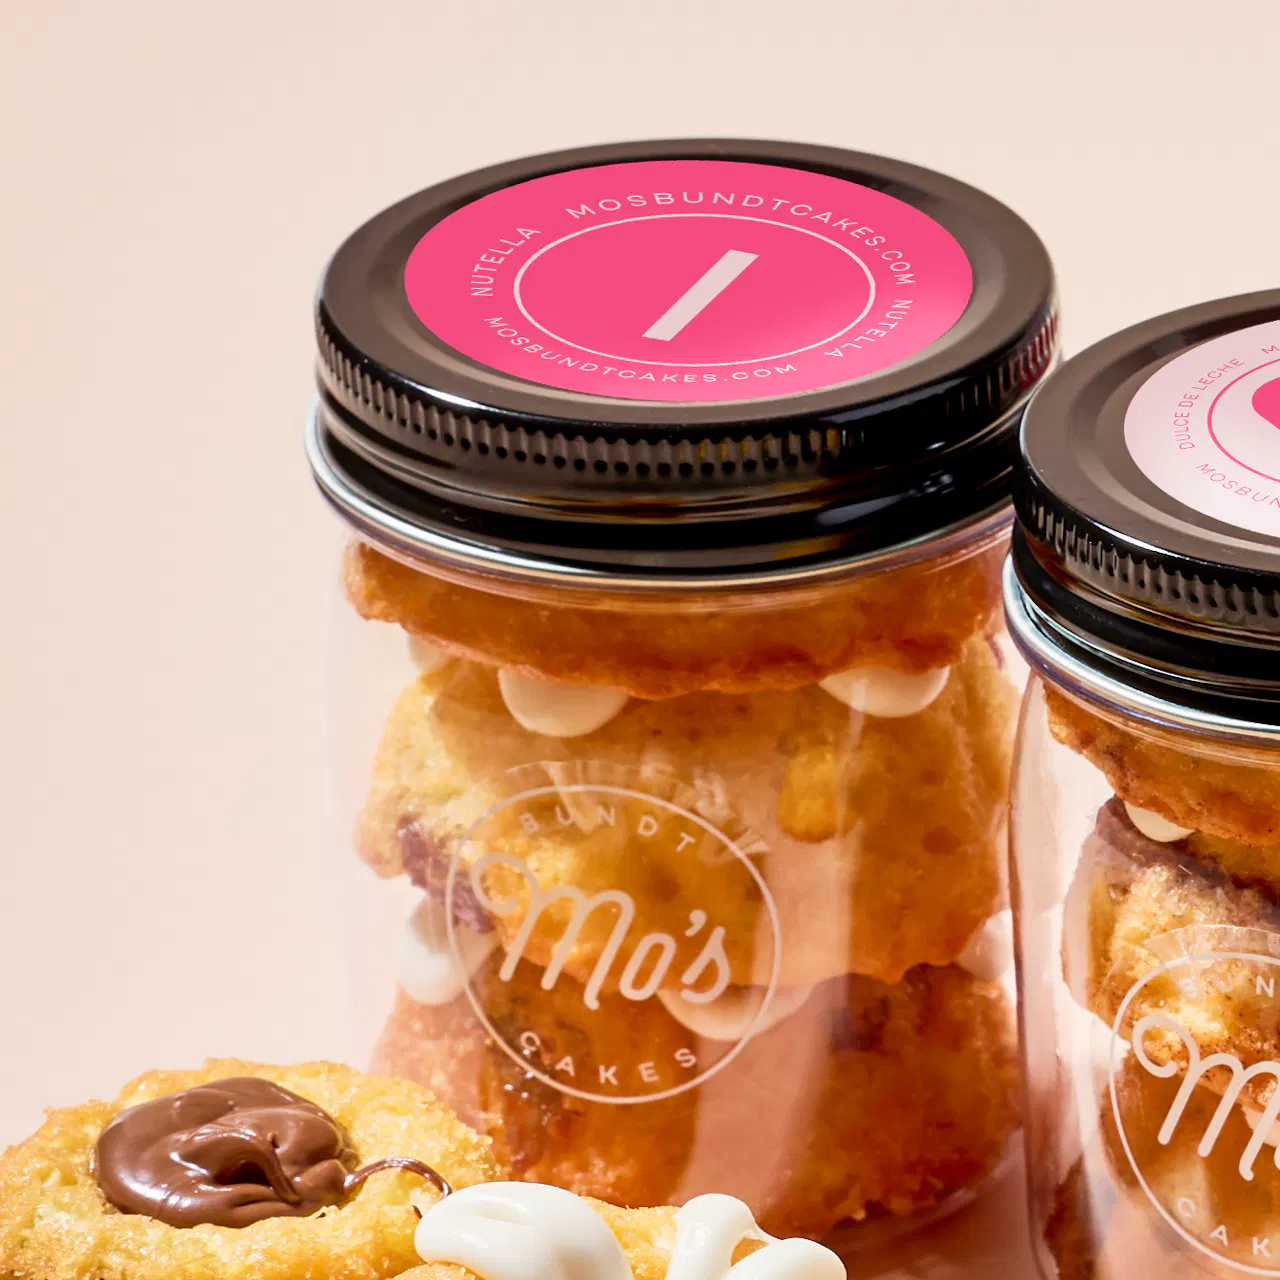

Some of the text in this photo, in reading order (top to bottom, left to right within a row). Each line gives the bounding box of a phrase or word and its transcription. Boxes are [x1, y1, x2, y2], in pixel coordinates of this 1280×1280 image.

[471, 227, 542, 297] NUTELLA
[565, 192, 916, 285] MOSBUNDTCAKES.COM
[484, 317, 797, 383] MOSBUNDTCAKES.COM
[824, 299, 913, 358] NUTELLA
[1173, 358, 1246, 450] DULCE DE LECHE
[519, 805, 697, 853] BUNDT
[470, 851, 732, 1010] Mo's
[519, 1031, 698, 1086] CAKES
